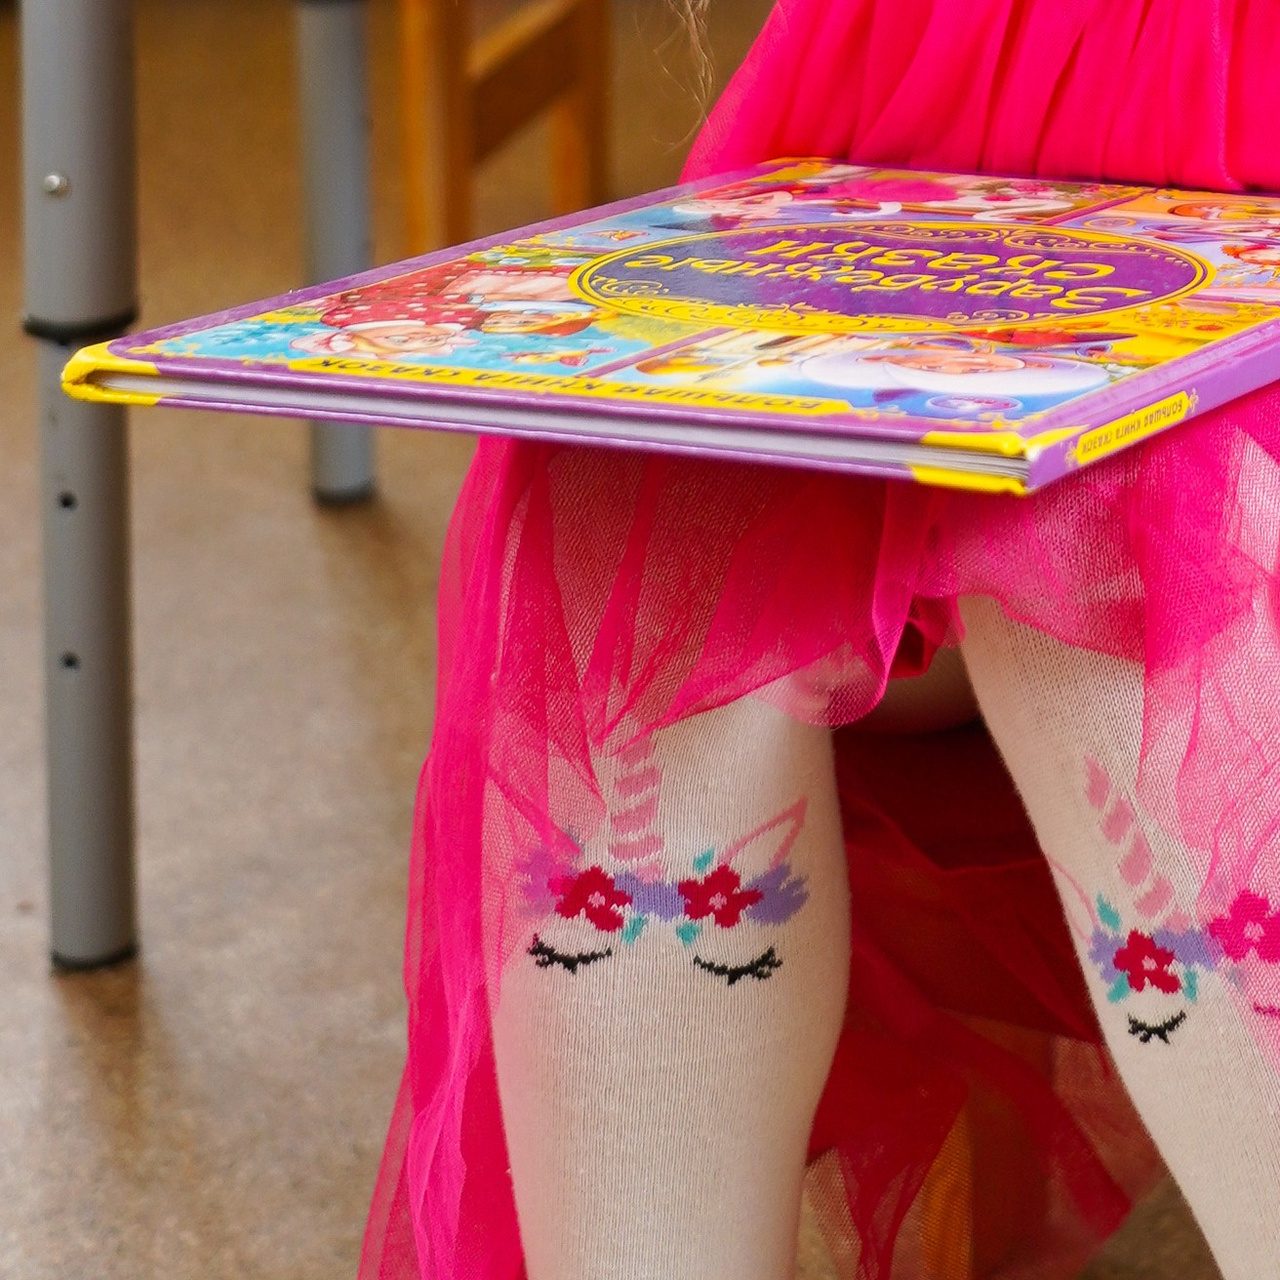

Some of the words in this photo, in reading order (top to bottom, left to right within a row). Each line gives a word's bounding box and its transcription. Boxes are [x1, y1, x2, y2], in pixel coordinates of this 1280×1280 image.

[744, 239, 1116, 279] сказки
[625, 254, 1149, 309] Зарубежные
[317, 359, 461, 379] СКАЗОК
[474, 373, 599, 392] КНИГА
[613, 387, 823, 410] БОЛЬШАЯ
[1144, 399, 1183, 430] БОЛЬШАЯ
[1116, 419, 1141, 439] КНИГА
[1081, 430, 1112, 454] СКАЗОК
